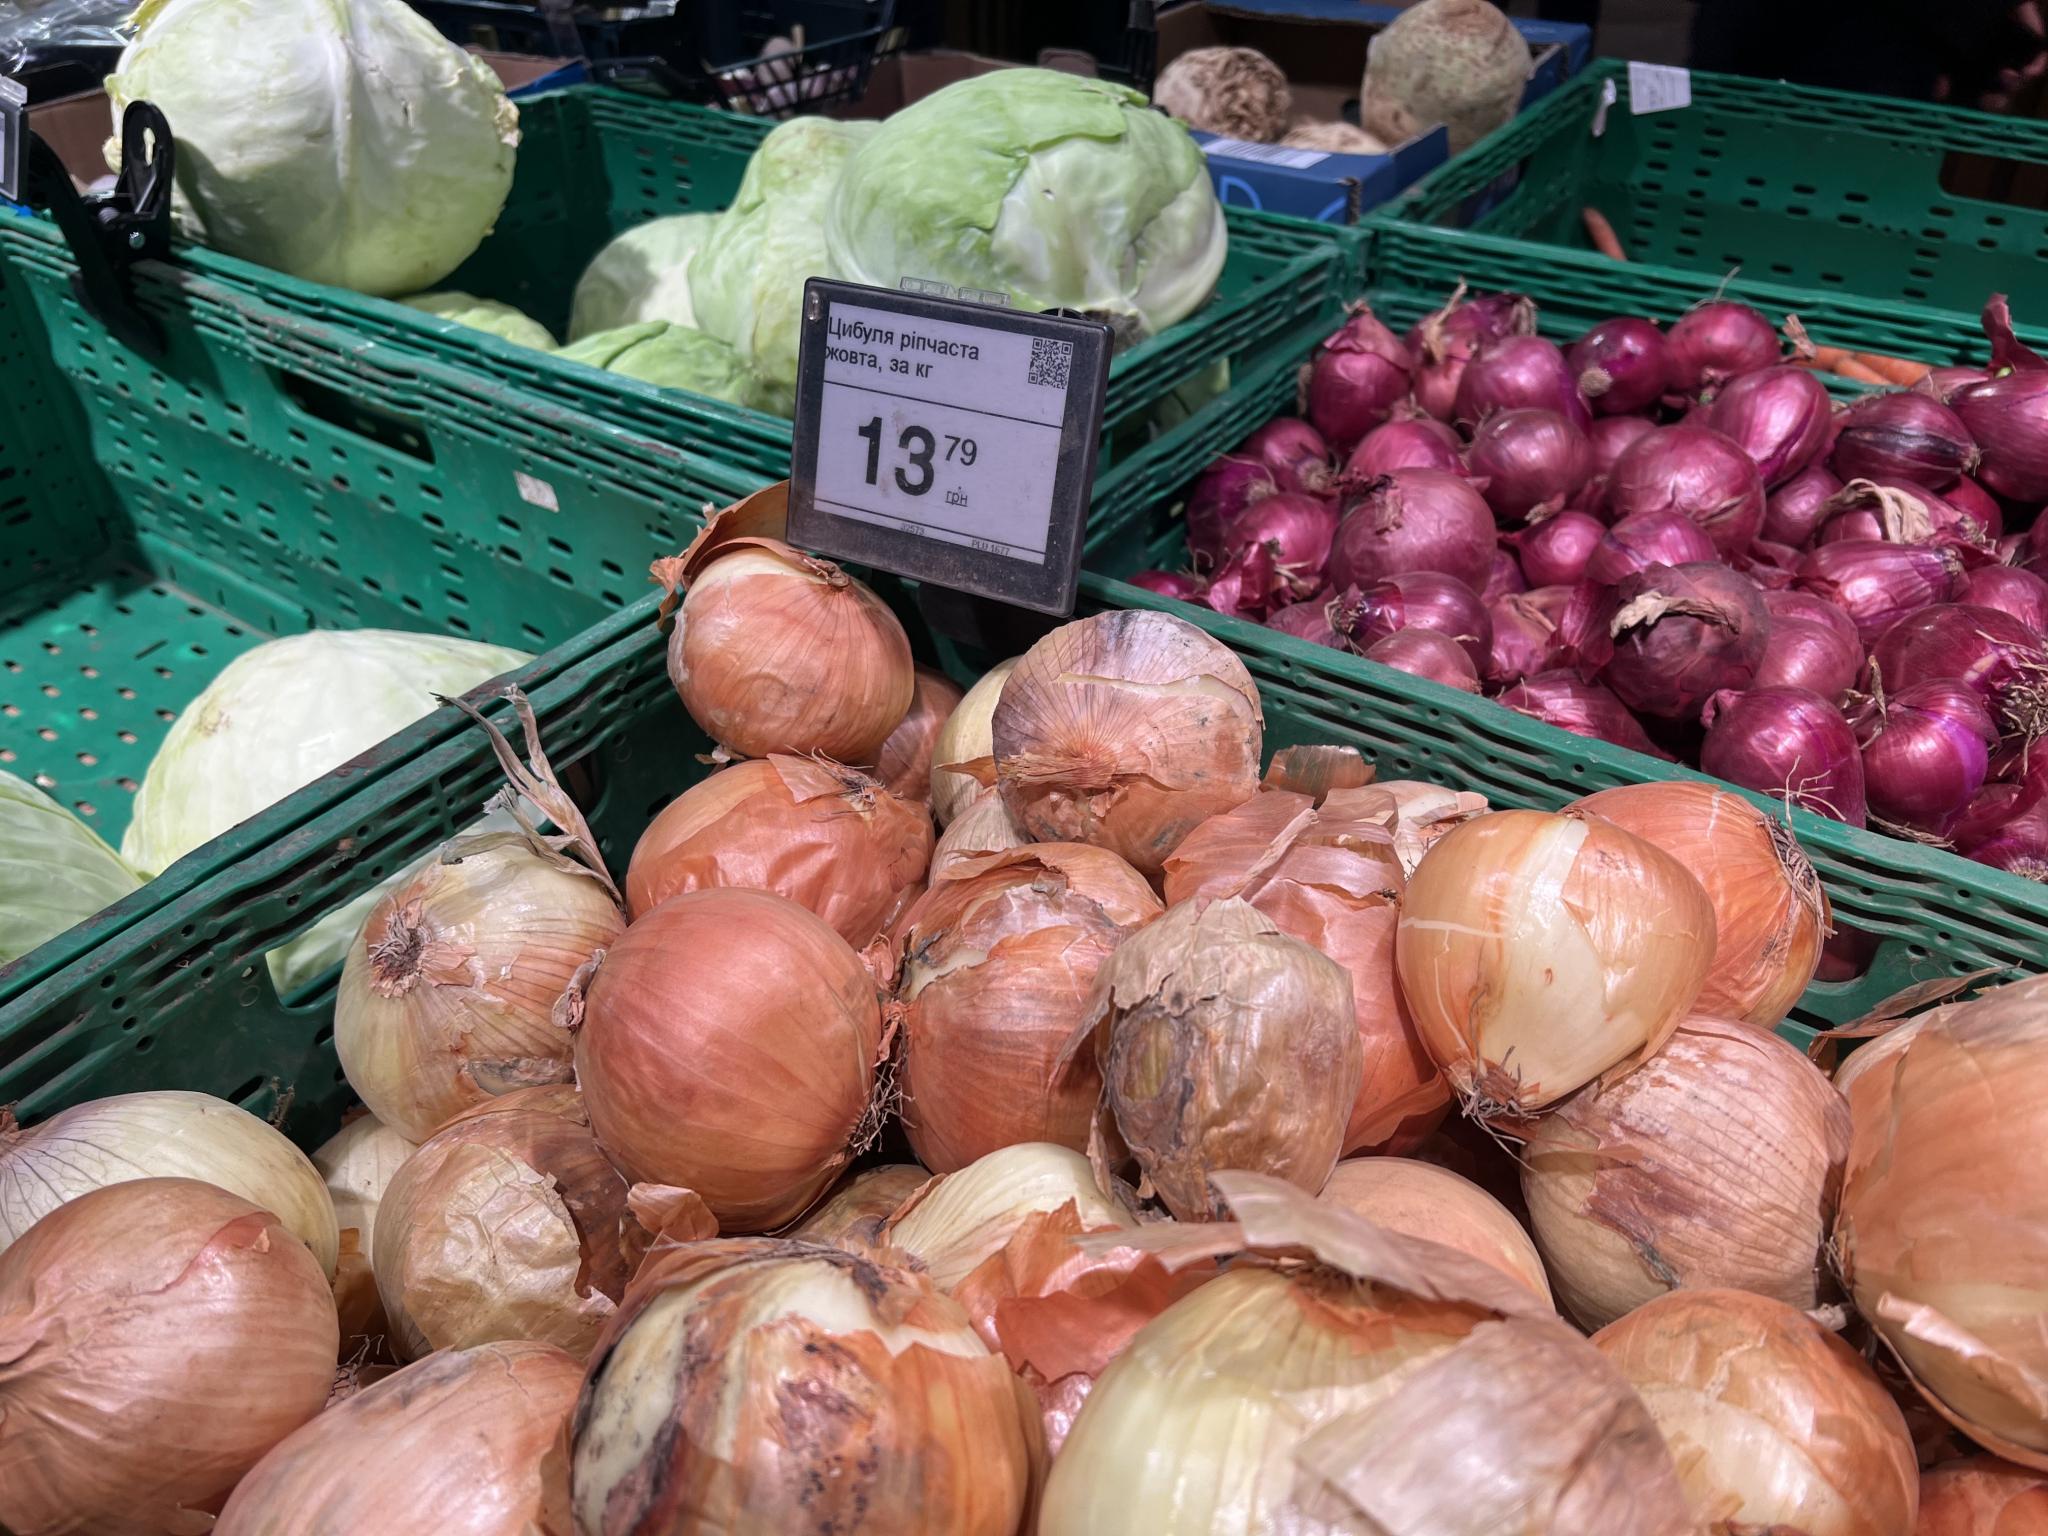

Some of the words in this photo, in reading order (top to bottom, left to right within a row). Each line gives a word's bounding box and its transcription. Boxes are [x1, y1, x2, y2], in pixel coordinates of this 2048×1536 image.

[828, 317, 894, 345] Цибуля
[900, 332, 980, 360] ріпчаста
[825, 346, 883, 373] жовта,
[890, 358, 910, 375] за
[916, 362, 934, 379] кг
[858, 416, 936, 496] 13
[944, 434, 978, 466] 79
[945, 490, 968, 507] грн
